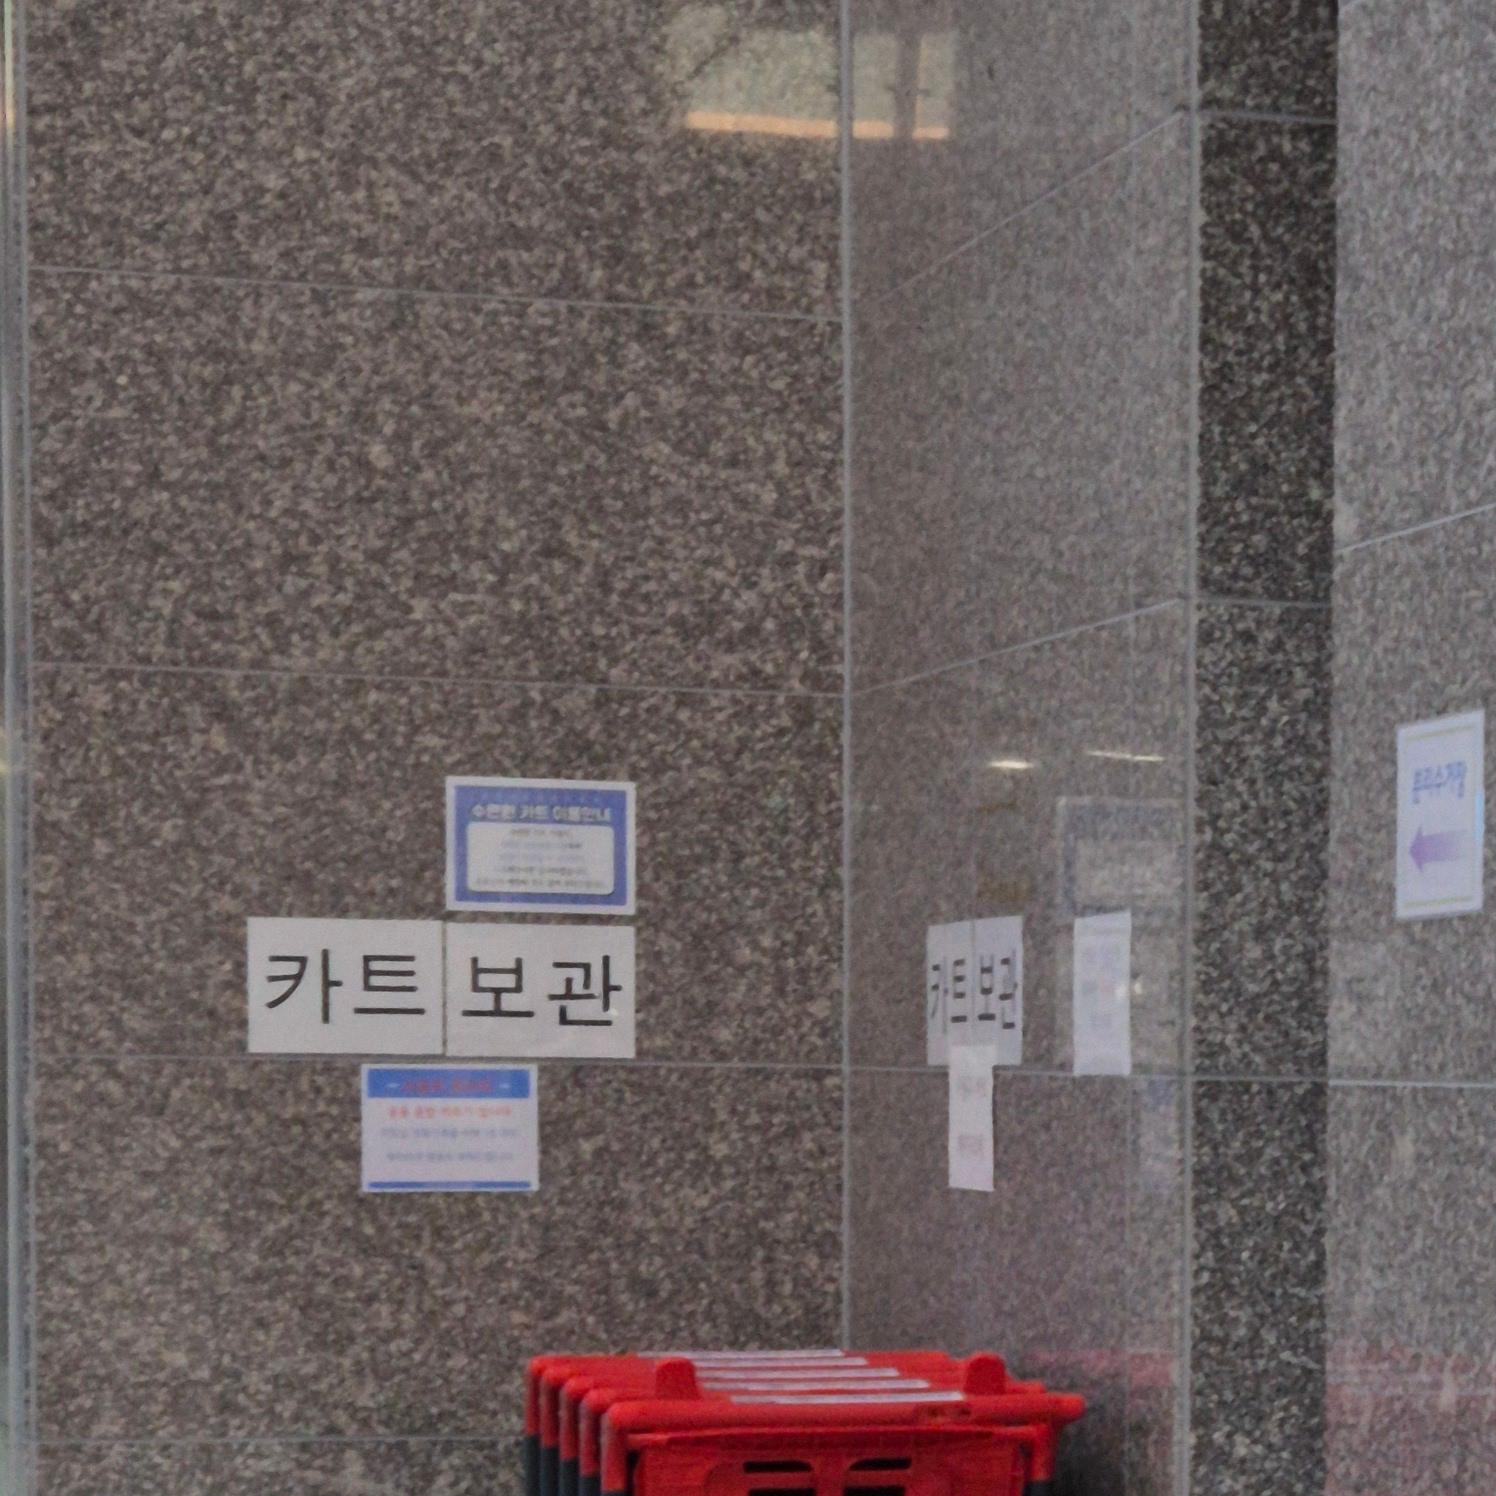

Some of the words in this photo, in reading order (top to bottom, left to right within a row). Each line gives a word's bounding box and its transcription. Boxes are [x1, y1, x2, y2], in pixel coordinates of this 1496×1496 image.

[519, 803, 548, 821] 카트
[265, 947, 426, 1025] 카트
[461, 954, 623, 1028] 보관
[930, 955, 967, 1034] 카트
[978, 948, 1018, 1029] 보관
